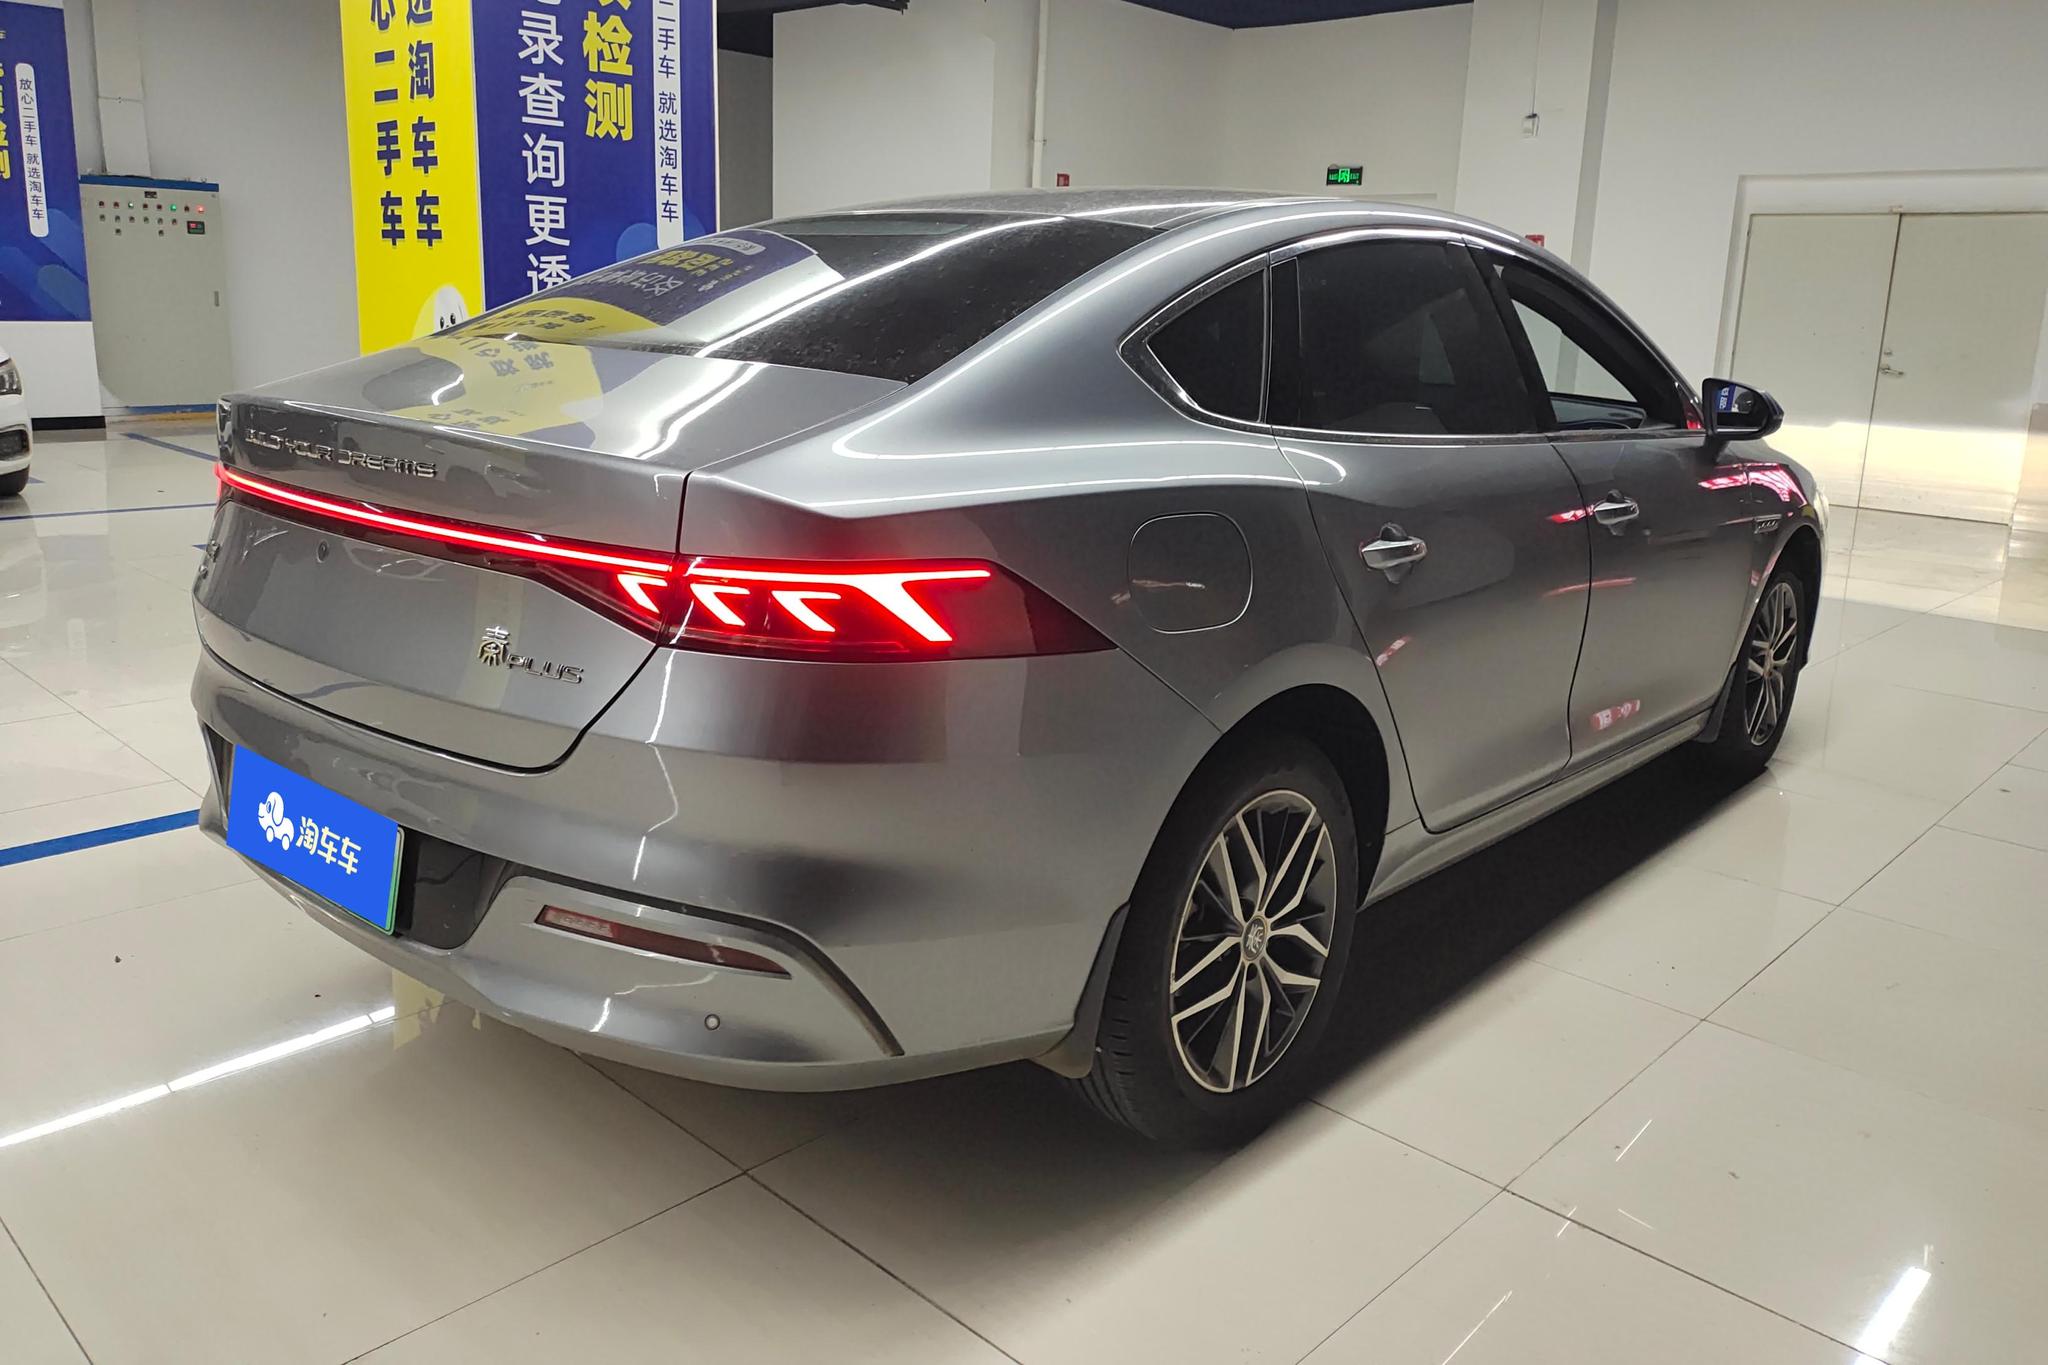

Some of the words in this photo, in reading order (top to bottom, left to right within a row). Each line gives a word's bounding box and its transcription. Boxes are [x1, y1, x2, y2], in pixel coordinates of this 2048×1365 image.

[582, 0, 634, 141] 检测
[19, 78, 38, 147] 放心二手车
[517, 0, 573, 295] 录查询更透
[658, 91, 680, 223] 就选淘车车
[25, 152, 45, 221] 就选淘车车
[338, 448, 438, 479] DREAMS
[507, 654, 585, 684] PLUS
